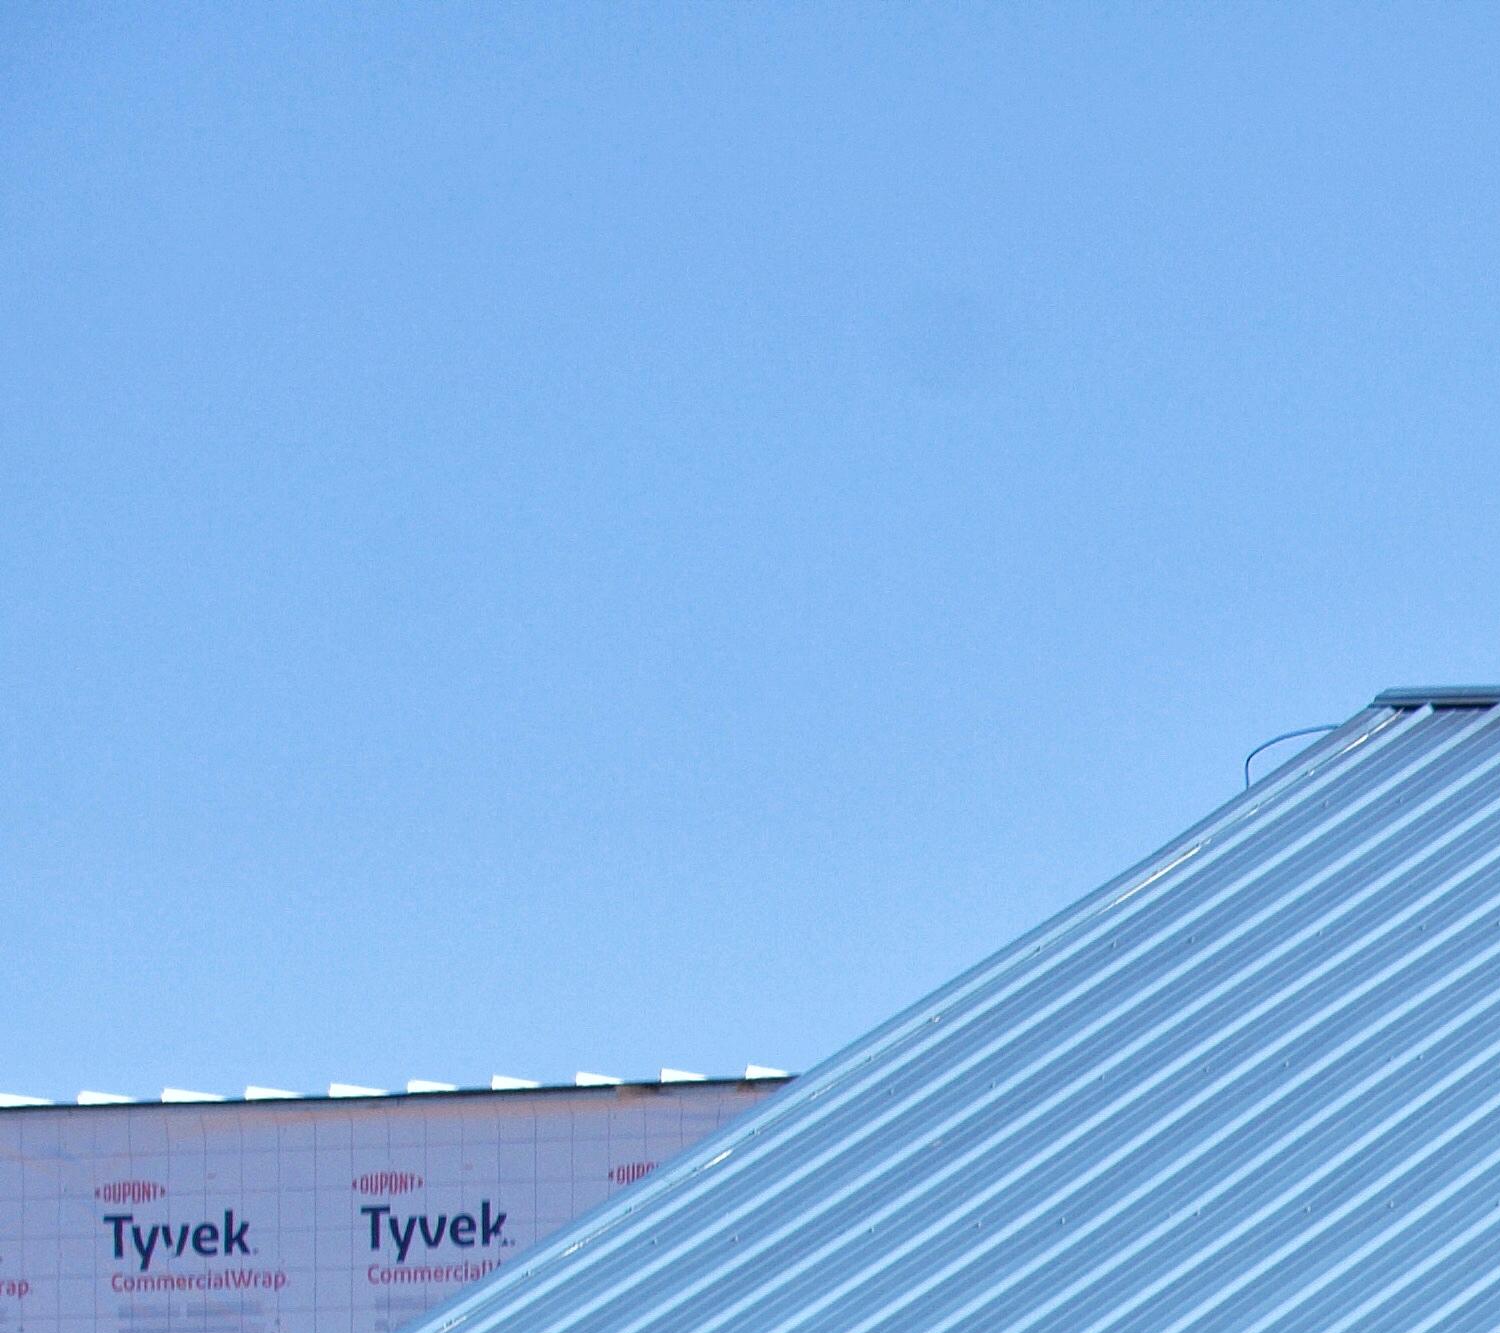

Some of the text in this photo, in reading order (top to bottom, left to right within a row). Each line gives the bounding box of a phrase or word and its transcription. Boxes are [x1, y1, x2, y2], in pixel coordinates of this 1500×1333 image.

[103, 1180, 159, 1205] DUPONT
[359, 1172, 416, 1197] DUPONT
[103, 1208, 251, 1271] Tyvek
[360, 1199, 507, 1264] Tyvek
[111, 1268, 286, 1293] CommercialWrap
[367, 1259, 501, 1285] Commercial
